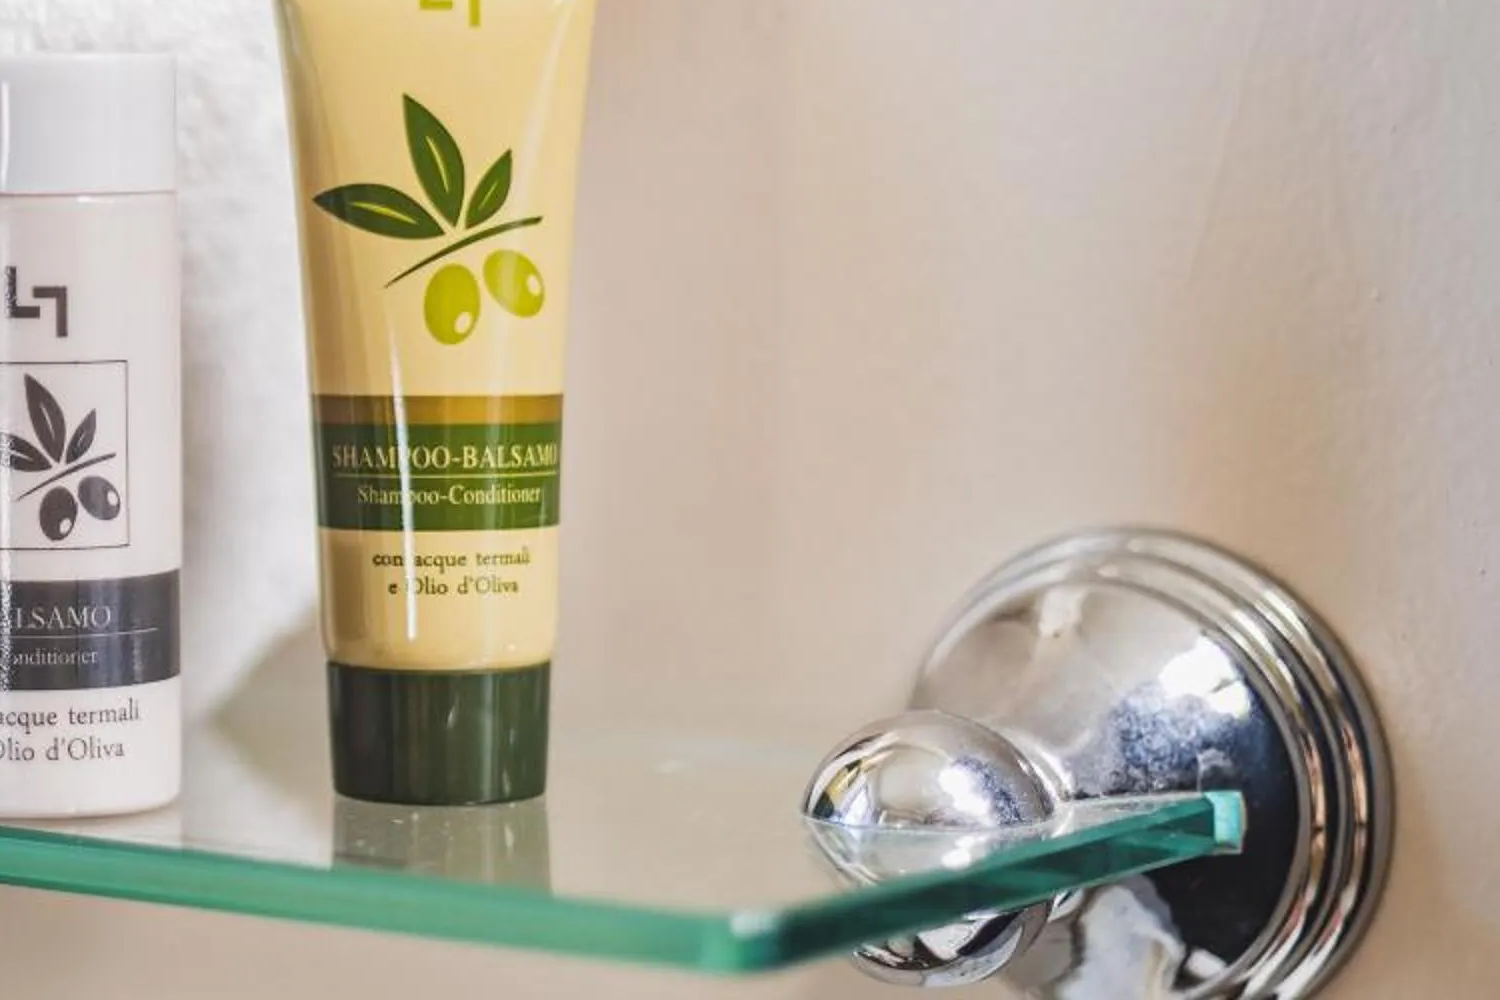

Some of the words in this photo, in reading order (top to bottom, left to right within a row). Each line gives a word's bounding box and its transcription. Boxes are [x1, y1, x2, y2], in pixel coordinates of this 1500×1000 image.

[332, 443, 558, 470] SHAMOO-BALSAMO
[371, 553, 404, 567] con
[412, 553, 467, 574] acque
[475, 544, 530, 567] termali
[388, 581, 399, 595] e
[405, 574, 449, 595] Olio
[457, 575, 519, 595] d'Oliva
[68, 697, 141, 725] termali
[45, 735, 126, 762] d'Oliva
